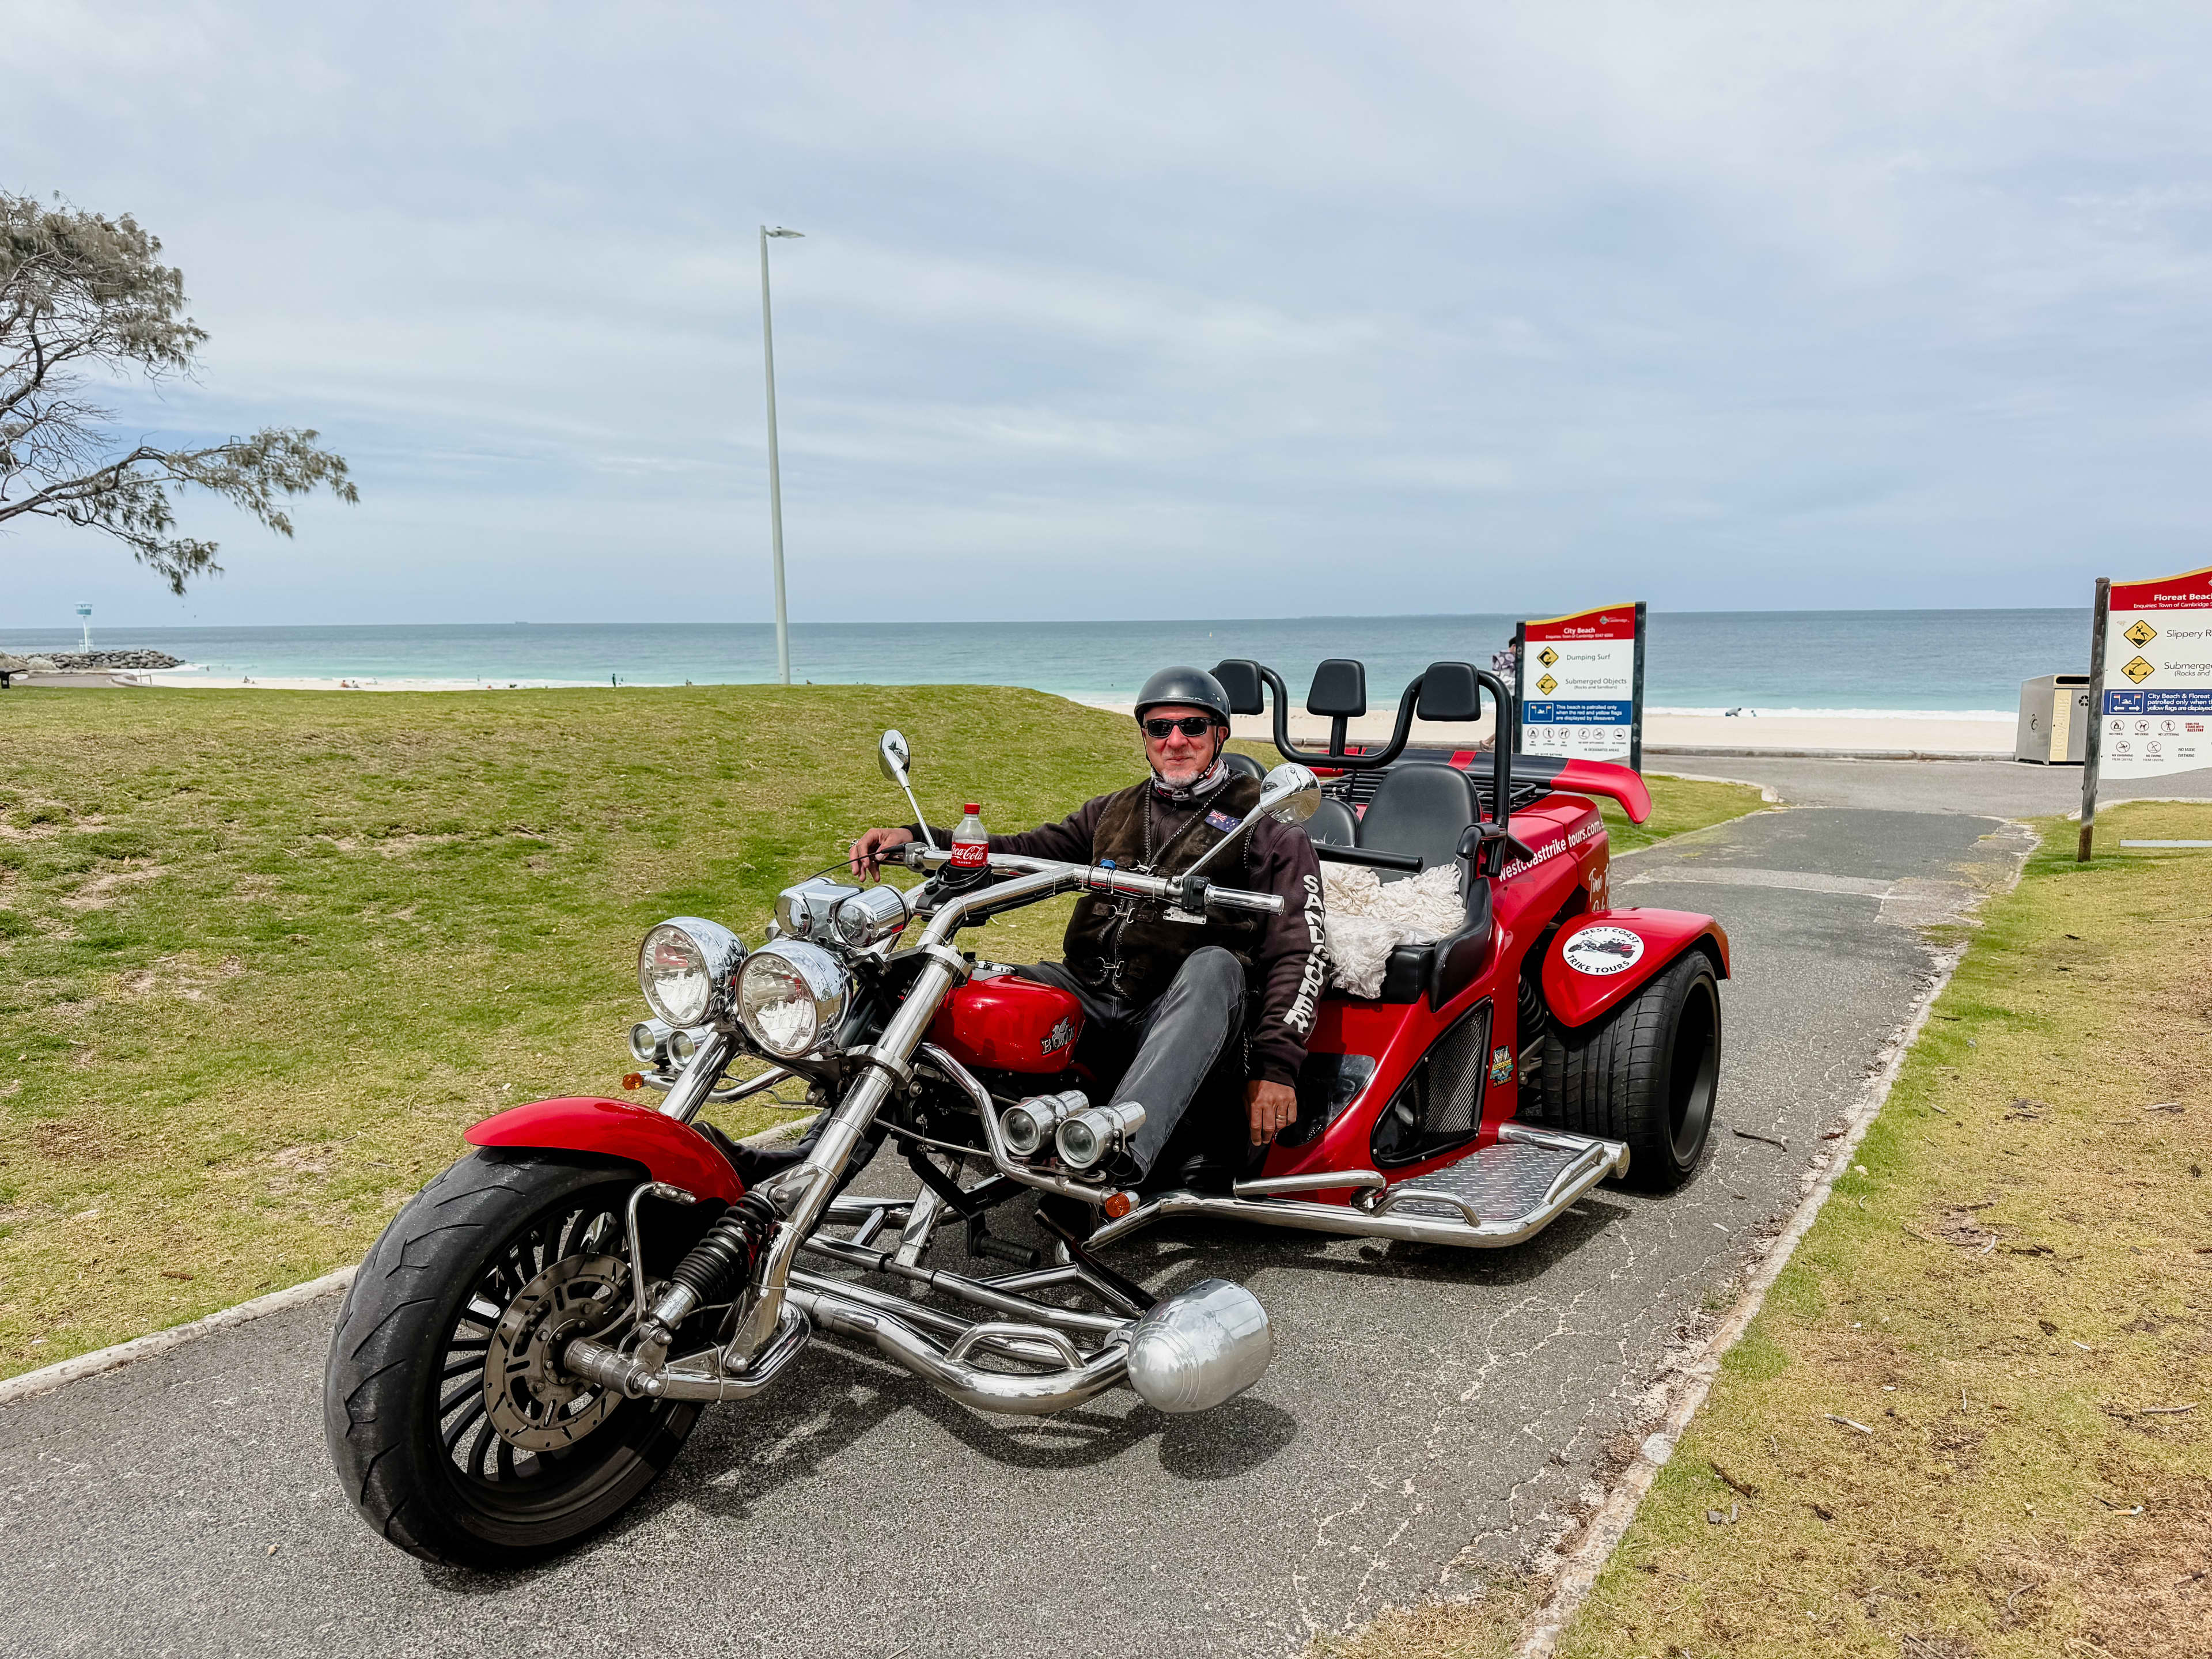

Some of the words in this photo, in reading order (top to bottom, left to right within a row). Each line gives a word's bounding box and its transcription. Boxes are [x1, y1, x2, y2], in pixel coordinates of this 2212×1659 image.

[2166, 629, 2203, 639] Slippery
[2164, 661, 2212, 671] Submerge
[1565, 677, 1601, 685] Submerged
[1603, 677, 1627, 685] Objects
[1579, 927, 1609, 936] WEST
[1612, 928, 1640, 944] COAST
[1567, 955, 1592, 972] TRIKE
[1594, 960, 1630, 973] TOURS
